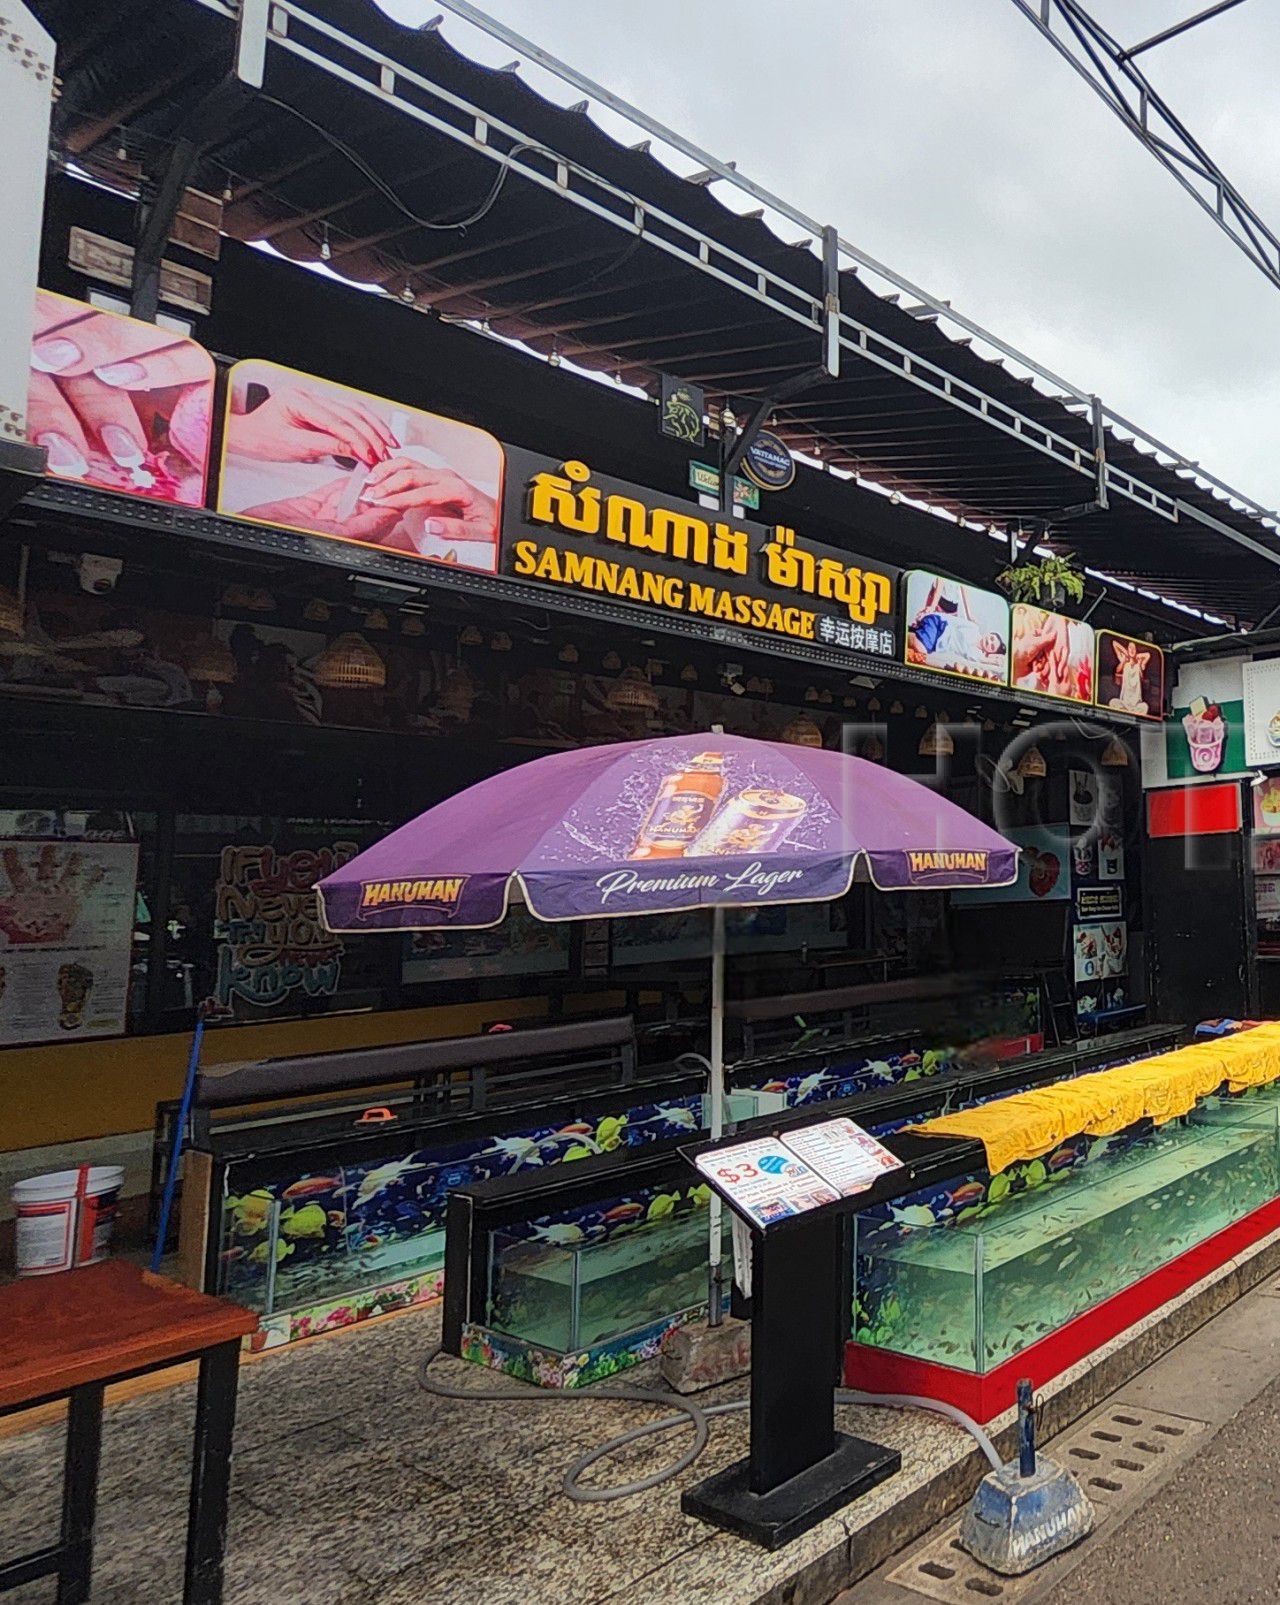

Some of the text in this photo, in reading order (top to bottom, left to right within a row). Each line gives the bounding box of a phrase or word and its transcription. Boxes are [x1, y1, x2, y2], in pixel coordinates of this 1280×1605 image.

[514, 541, 817, 640] SAMNANG MASSAGE
[819, 615, 893, 656] 幸运按摩店
[596, 861, 804, 905] Premium Lager
